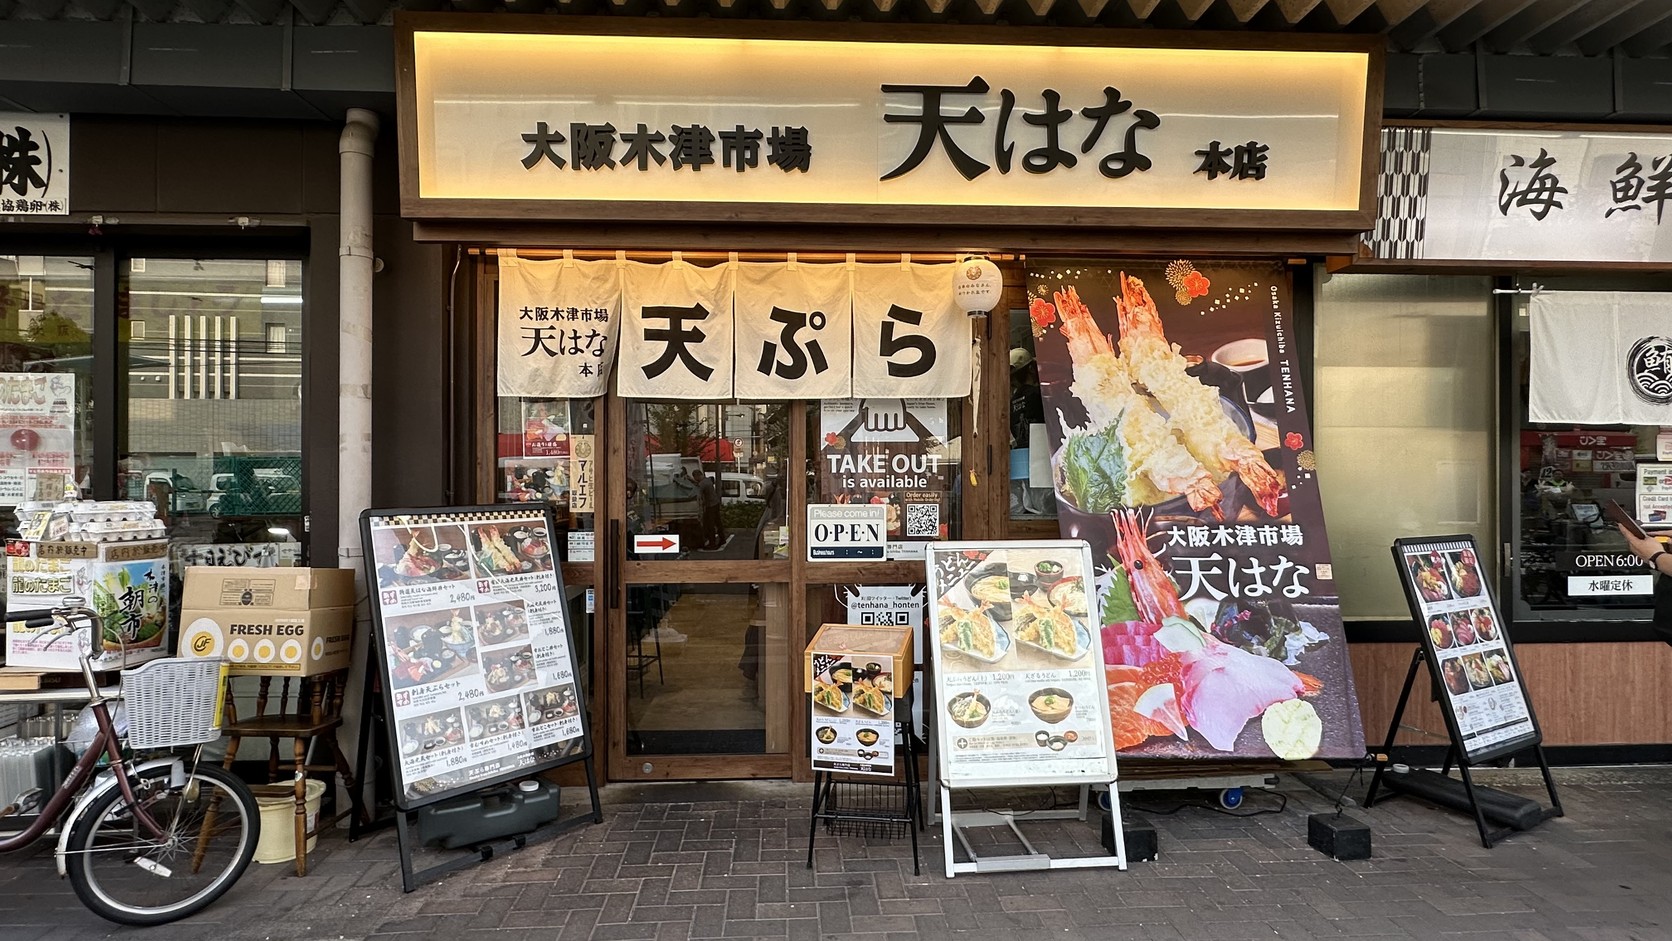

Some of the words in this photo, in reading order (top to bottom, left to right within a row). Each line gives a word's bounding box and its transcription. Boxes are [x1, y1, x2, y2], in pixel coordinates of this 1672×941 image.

[880, 75, 1161, 181] 天はな
[521, 121, 812, 173] 大阪木津市場
[1193, 140, 1270, 181] 本店
[519, 306, 609, 323] 大阪木津市場
[520, 324, 608, 358] 天はな
[641, 302, 937, 382] 天ぷら
[1270, 285, 1279, 310] Osaka
[1280, 360, 1296, 413] TENHANA
[827, 454, 886, 474] TAKE
[892, 454, 942, 474] OUT
[578, 460, 588, 509] マルエフ
[842, 475, 855, 488] is
[860, 475, 928, 488] available
[813, 509, 843, 518] Please
[843, 510, 868, 518] come
[869, 509, 880, 518] in!
[1167, 524, 1304, 548] 大阪木津市場
[1575, 555, 1615, 567] OPEN
[1171, 552, 1310, 601] 天はな
[1588, 579, 1634, 591] 水曜定休
[118, 586, 145, 641] 朝市
[850, 602, 920, 610] @tenhana_honten
[230, 624, 273, 636] FRESH
[276, 624, 304, 636] EGG
